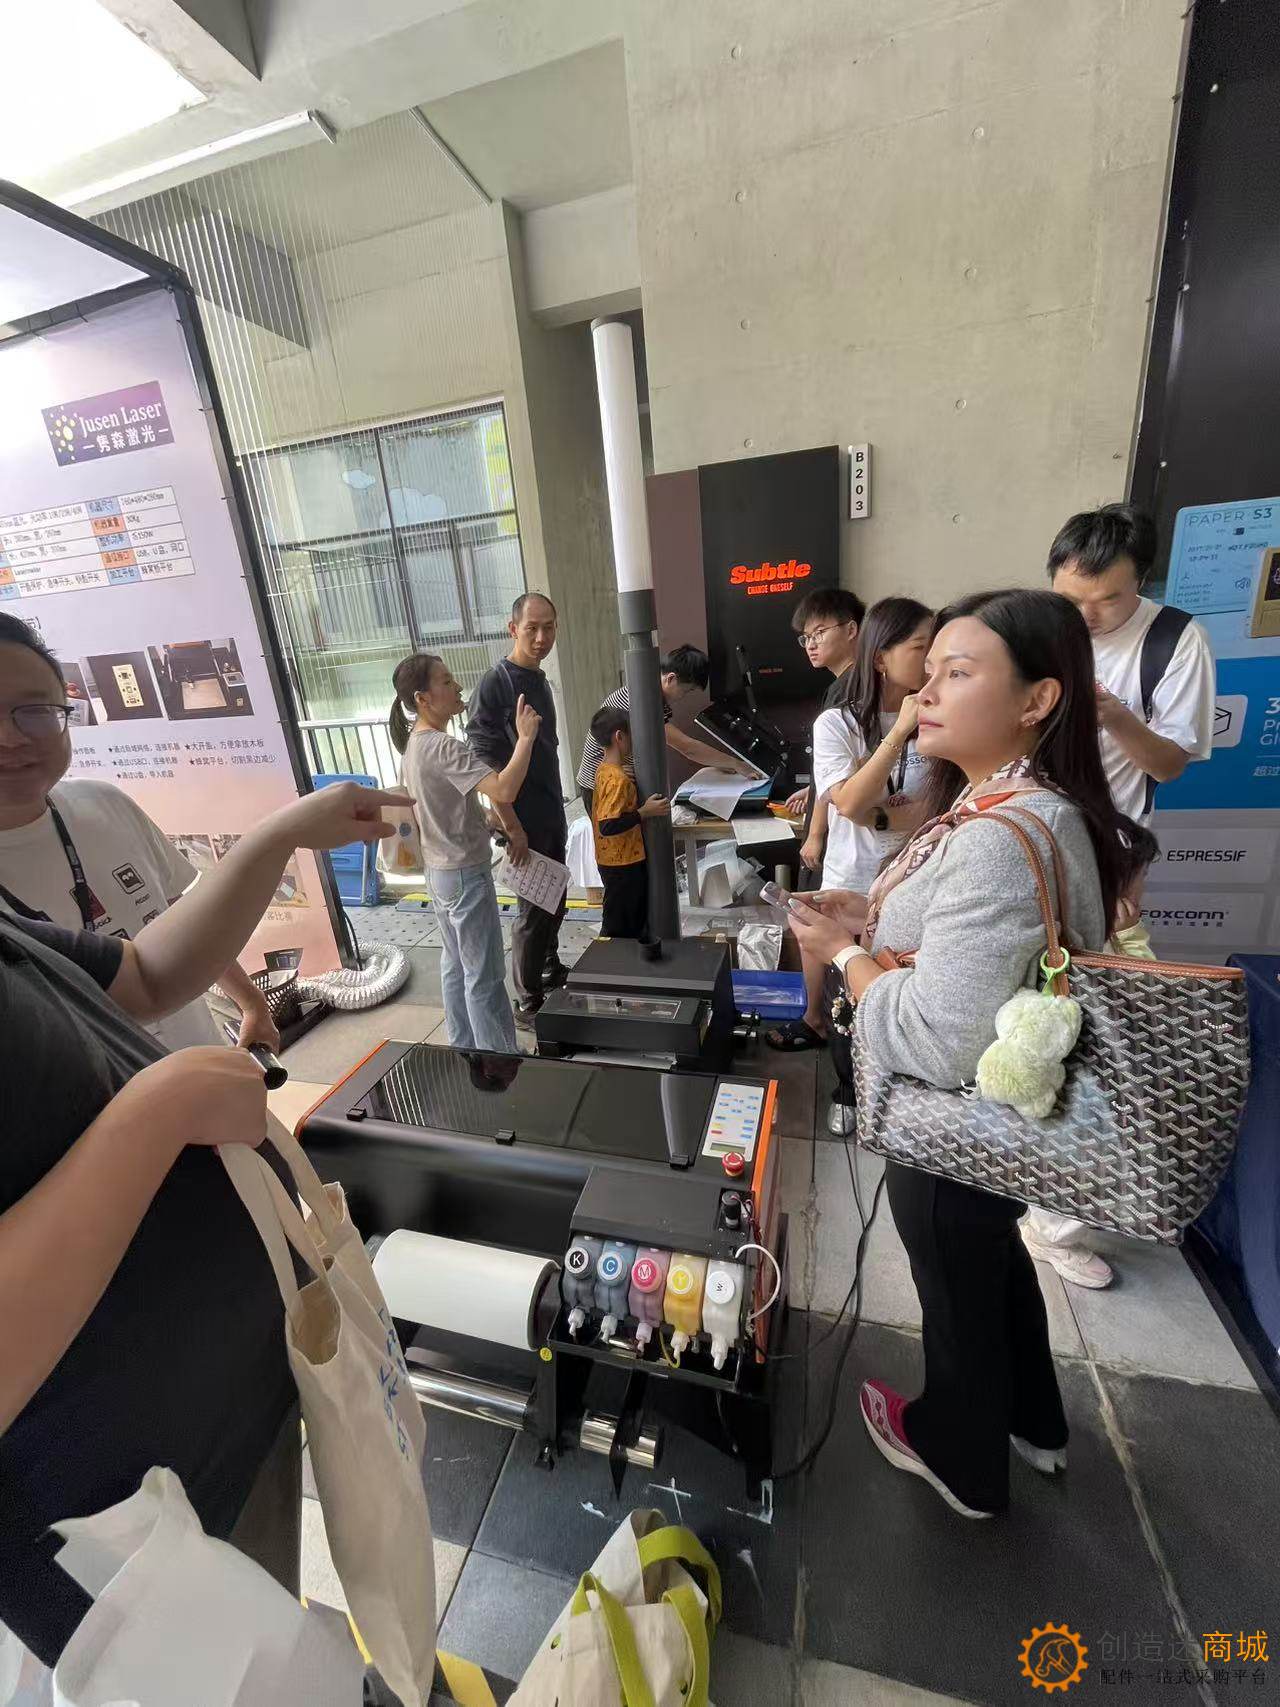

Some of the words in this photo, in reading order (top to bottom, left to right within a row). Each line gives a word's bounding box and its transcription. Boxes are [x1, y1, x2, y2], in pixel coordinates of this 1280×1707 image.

[78, 413, 119, 438] Jusen
[121, 401, 163, 425] Laser
[855, 451, 864, 511] B203
[1189, 511, 1245, 526] PAPER
[1252, 507, 1273, 519] S3
[729, 559, 812, 585] Subtle
[1167, 850, 1248, 862] ESPRESSIF
[572, 1254, 582, 1266] K
[606, 1260, 615, 1272] C
[638, 1266, 651, 1279] M
